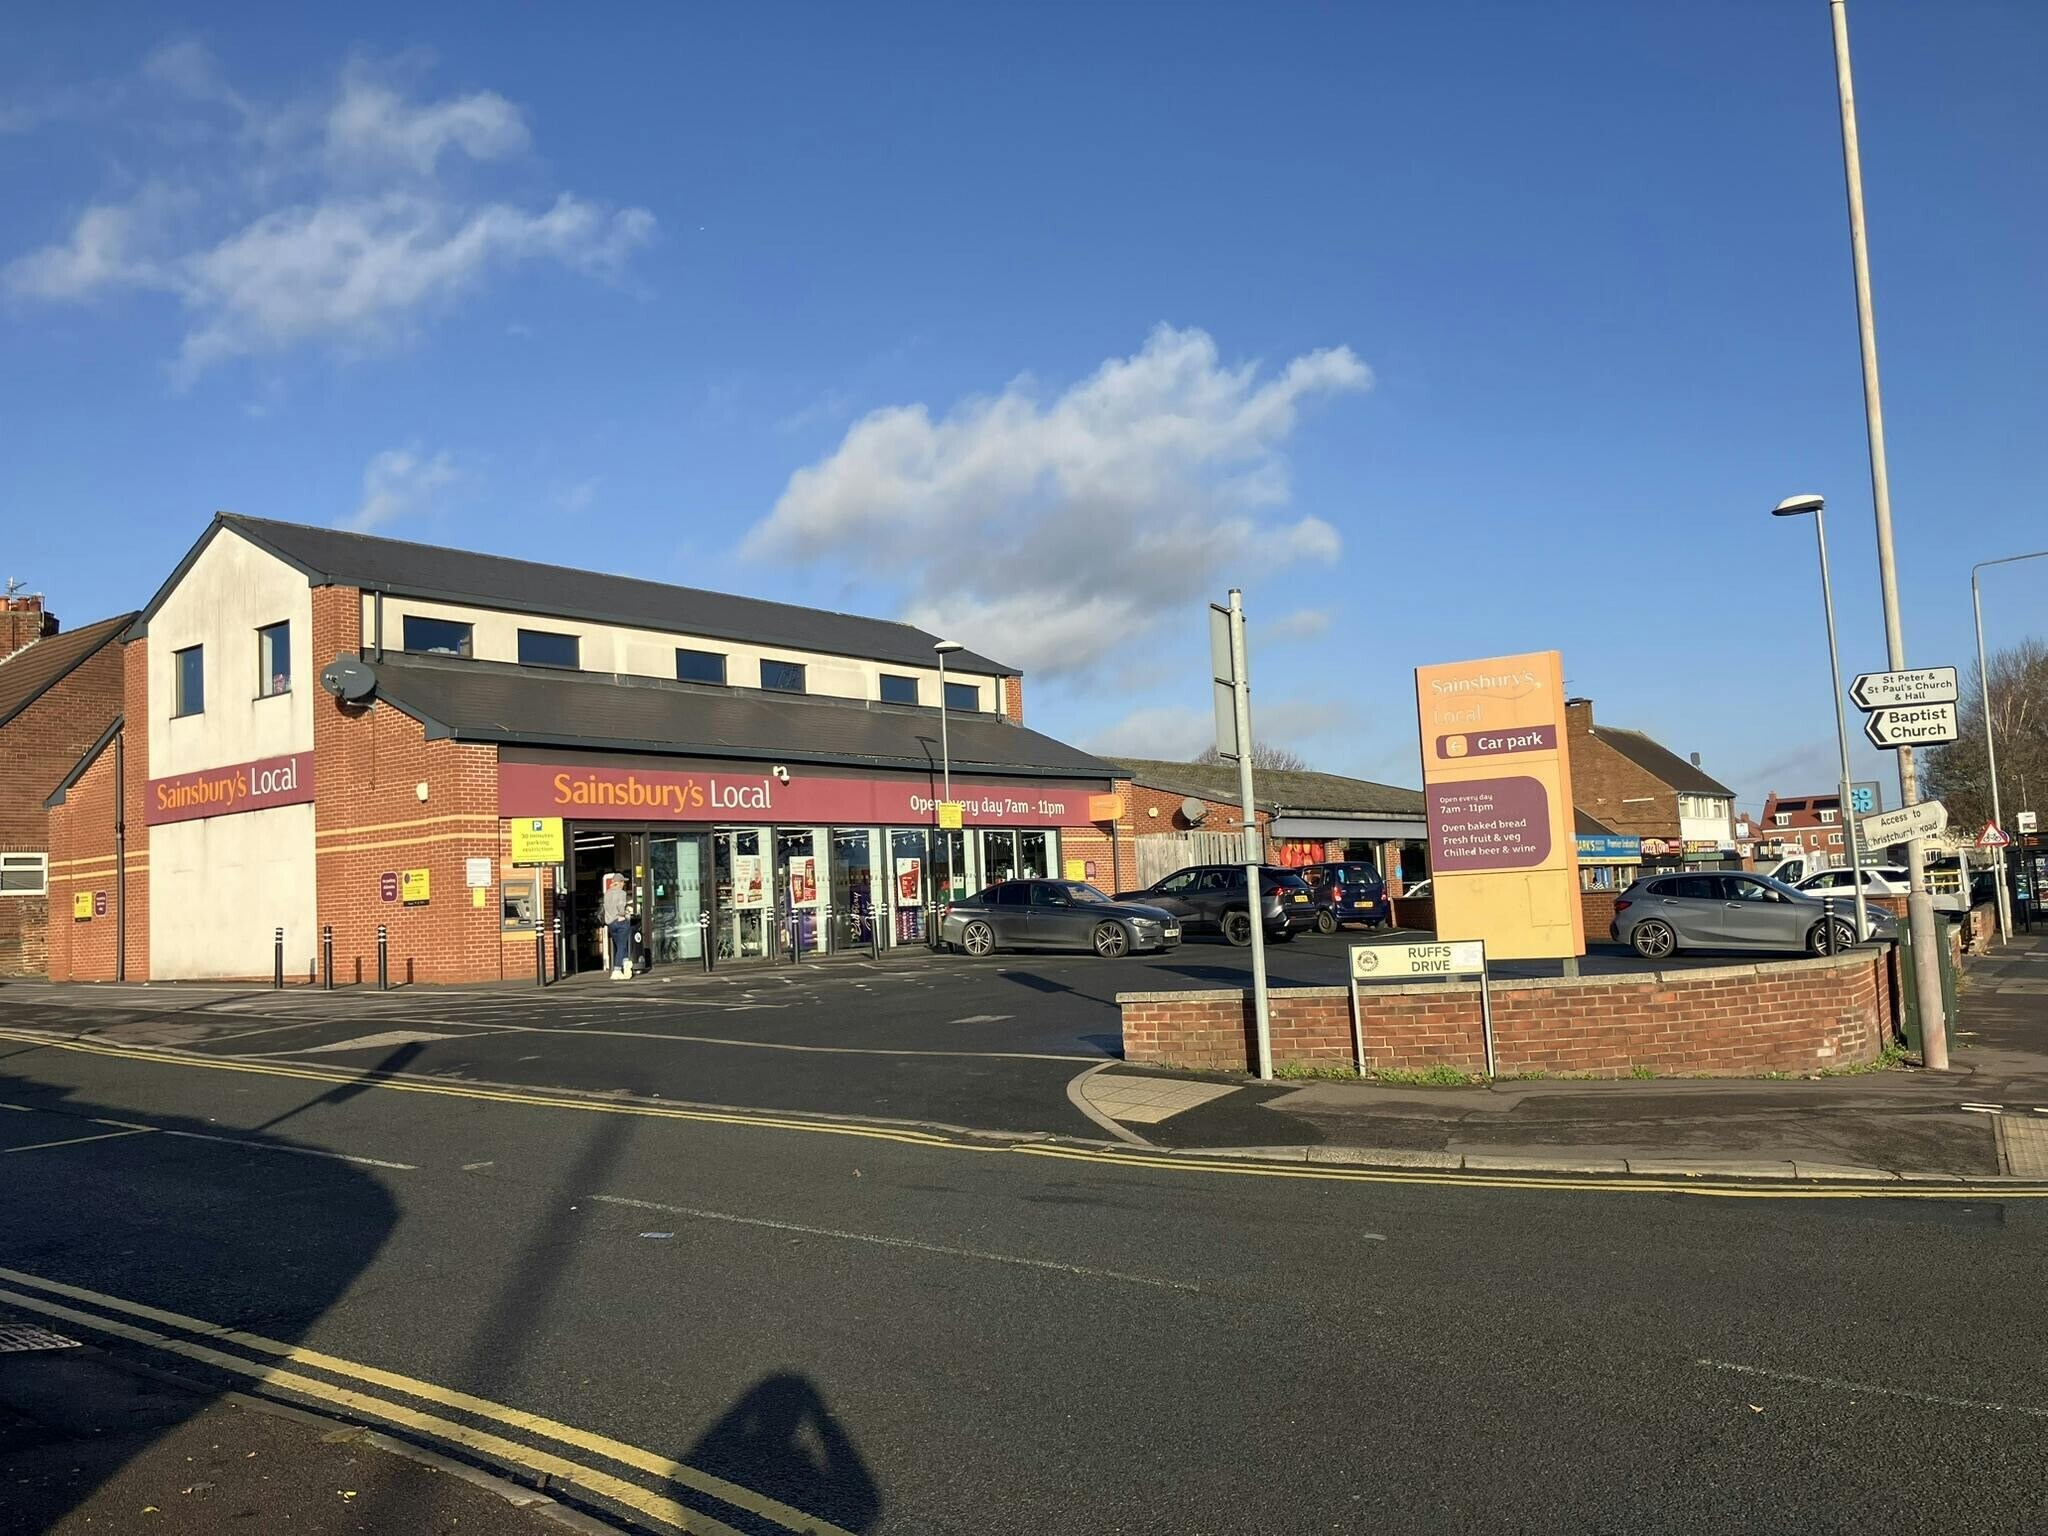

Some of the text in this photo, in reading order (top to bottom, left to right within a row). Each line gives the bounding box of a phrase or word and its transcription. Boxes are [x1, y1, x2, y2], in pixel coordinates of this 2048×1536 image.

[1431, 670, 1535, 696] Sainsbury's
[1883, 672, 1935, 684] St Peter &
[1867, 680, 1953, 694] St Paul's Church
[1905, 692, 1926, 700] Hall
[1433, 703, 1482, 725] Local
[1889, 708, 1947, 724] Baptist
[1890, 724, 1947, 739] Church
[1477, 732, 1543, 750] Car park
[157, 757, 298, 811] Sainsbury's Local
[553, 773, 772, 813] Sainsbury's Local
[1439, 796, 1458, 804] Open
[1479, 793, 1493, 801] day
[910, 795, 941, 815] Open
[946, 798, 979, 817] ery
[982, 797, 1003, 817] day
[1005, 799, 1029, 814] 7am
[1038, 800, 1065, 817] 11pm
[1440, 805, 1461, 814] 7am
[1469, 803, 1494, 814] 11pm
[1880, 809, 1921, 826] Access to
[1442, 818, 1527, 832] Oven baked bread
[1443, 833, 1521, 845] Fresh fruit & veg
[1443, 844, 1537, 857] Chilled beer & wine
[1408, 946, 1452, 958] RUFFS
[1411, 960, 1451, 972] DRIVE
